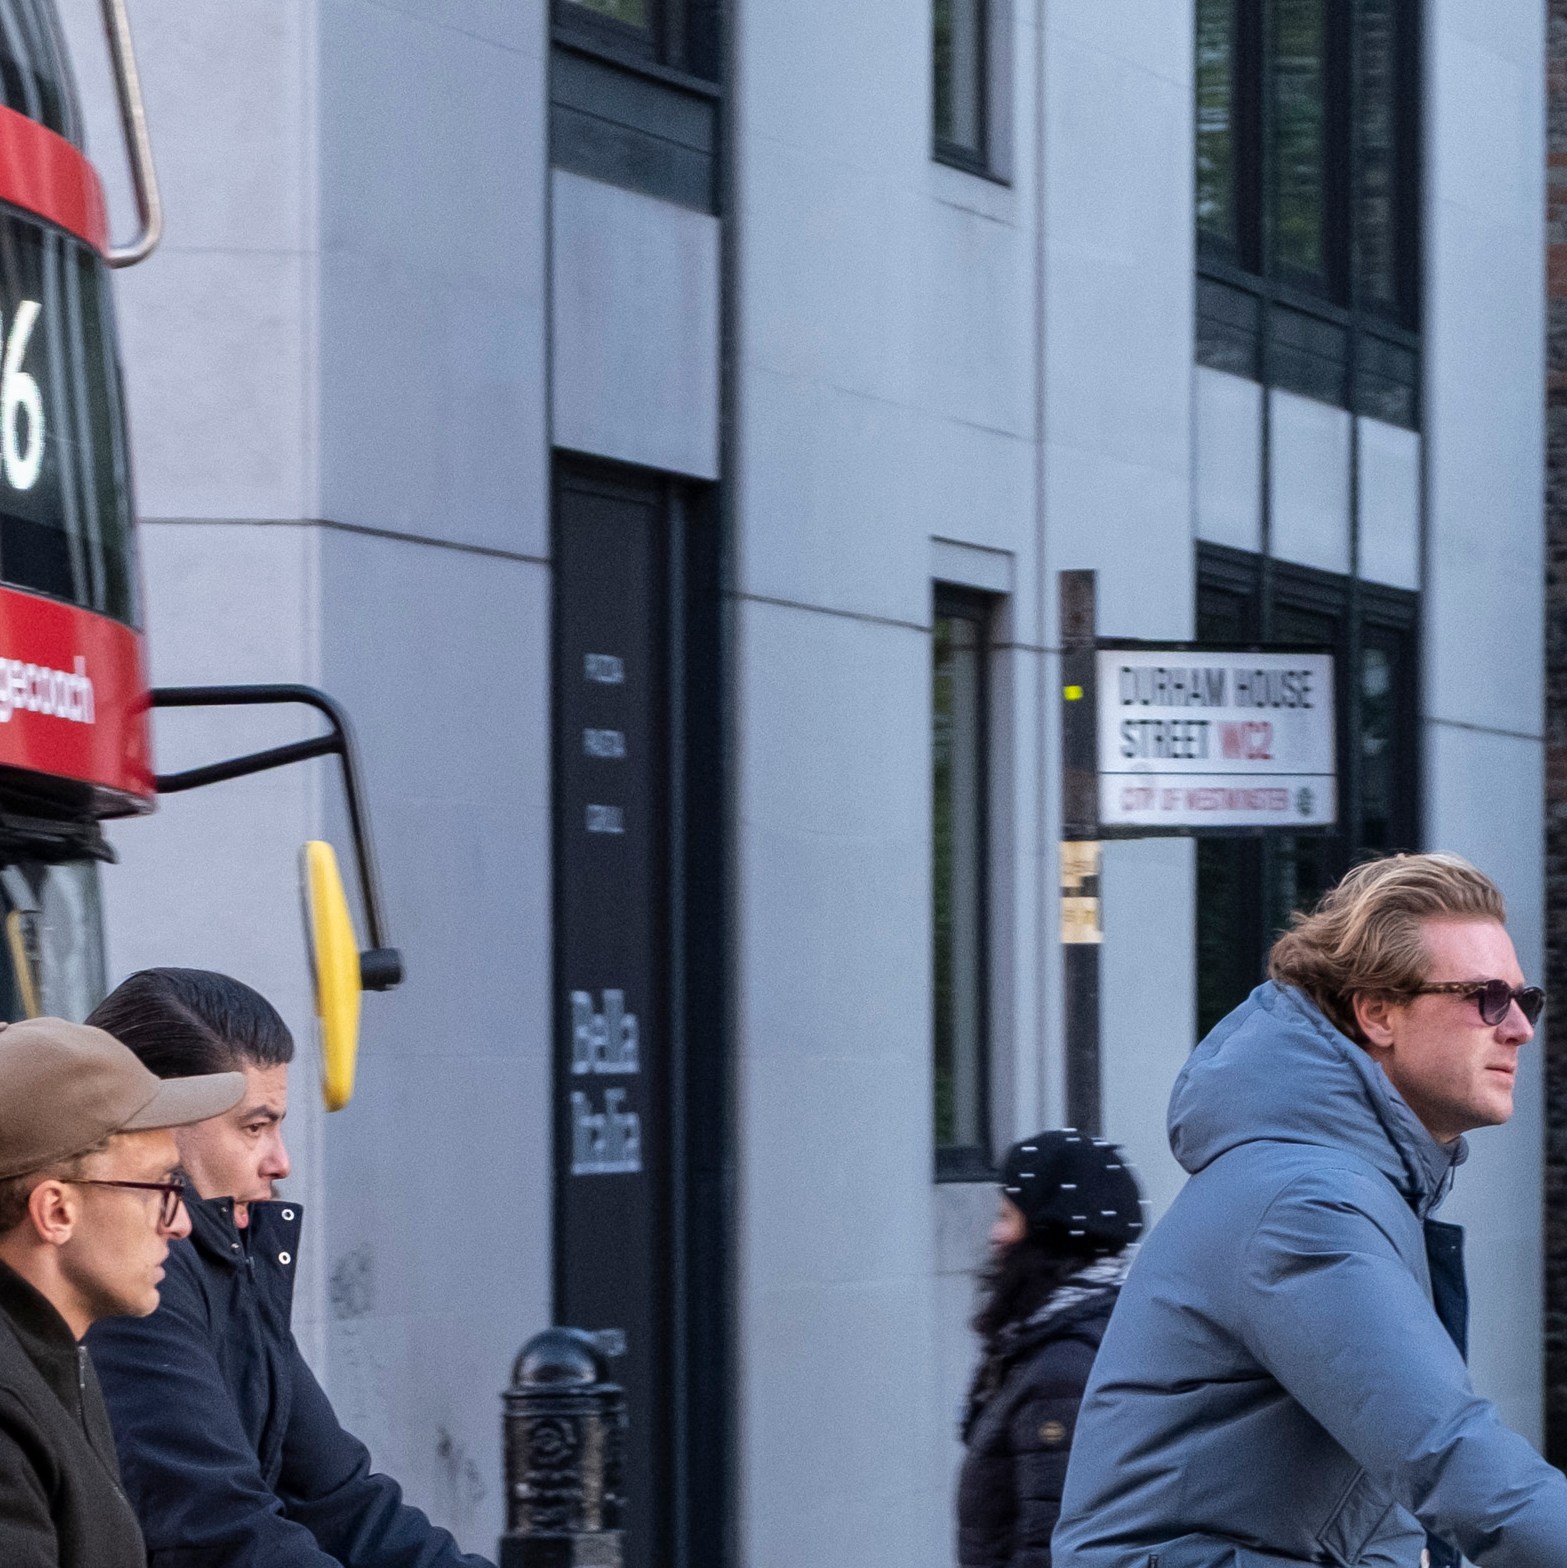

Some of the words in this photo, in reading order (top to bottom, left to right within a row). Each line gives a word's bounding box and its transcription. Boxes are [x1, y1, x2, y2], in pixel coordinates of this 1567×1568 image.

[1120, 666, 1227, 707] DURHAM
[1233, 669, 1313, 708] HOUSE
[1120, 718, 1209, 759] STREET
[1218, 721, 1274, 760] WC2
[1122, 787, 1153, 811] CITY
[1162, 788, 1181, 811] OF
[1186, 787, 1289, 811] WESTMINSTER
[571, 988, 640, 1074] Bella
